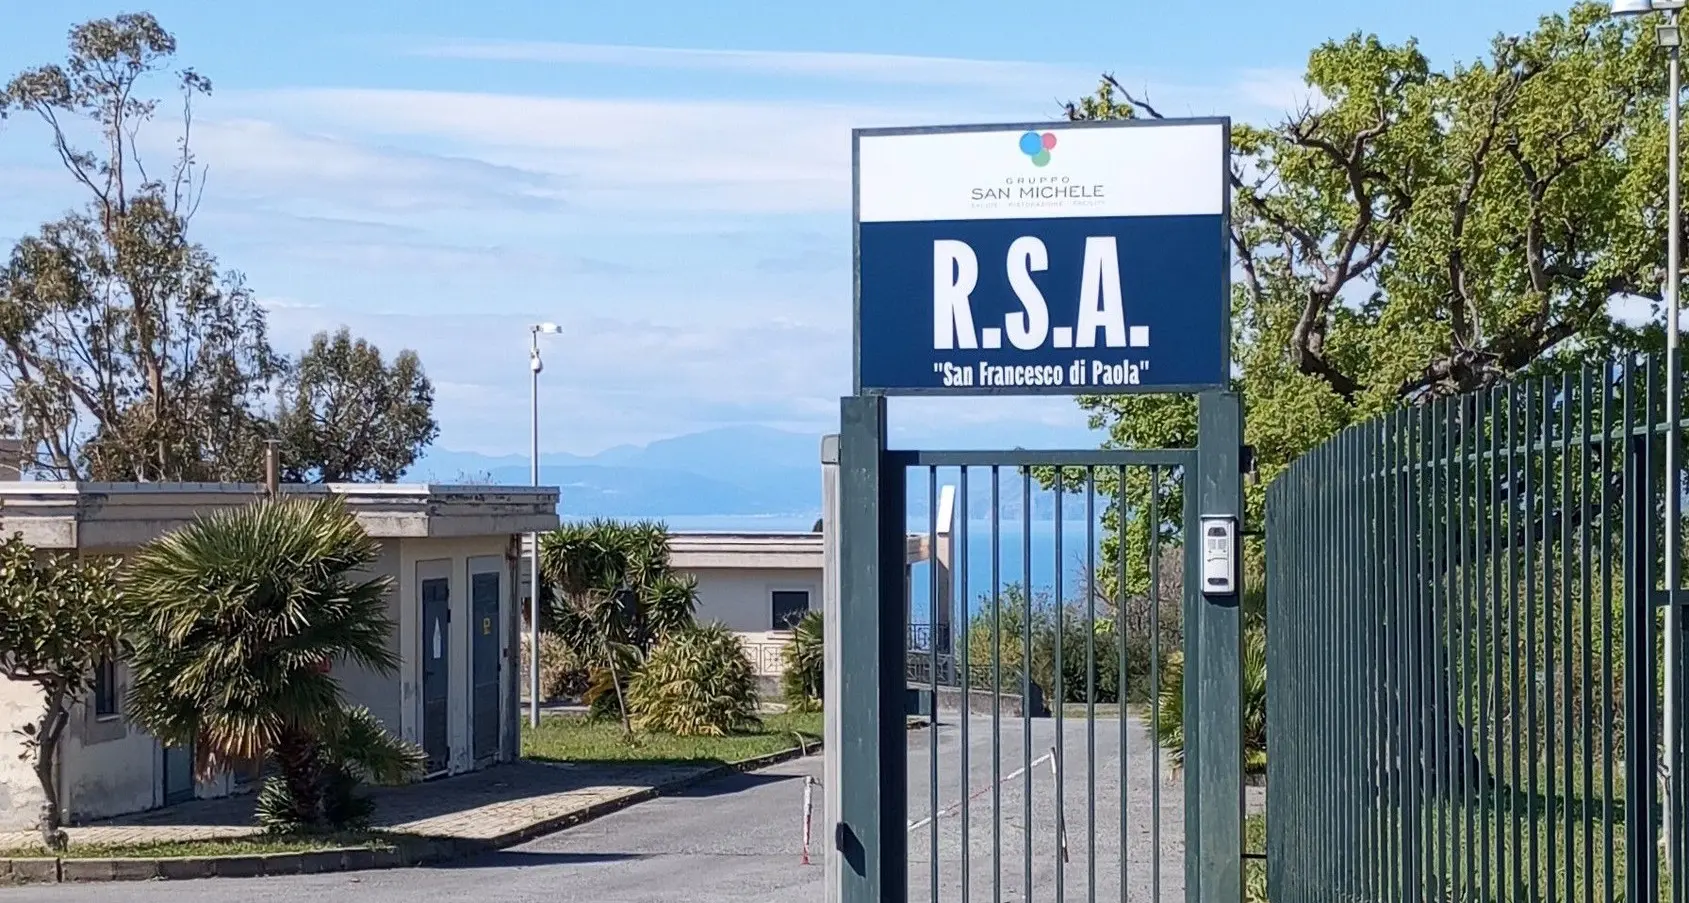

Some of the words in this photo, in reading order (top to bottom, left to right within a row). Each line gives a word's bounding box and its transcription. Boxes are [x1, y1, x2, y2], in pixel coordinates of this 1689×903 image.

[1006, 176, 1070, 185] GRUPPO
[971, 187, 1010, 200] SAN
[1019, 185, 1105, 199] MICHELE
[934, 235, 1149, 350] R.S.A.
[934, 361, 973, 386] "San
[979, 361, 1063, 386] Francesco
[1069, 359, 1086, 385] di
[1092, 359, 1149, 385] Paola"
